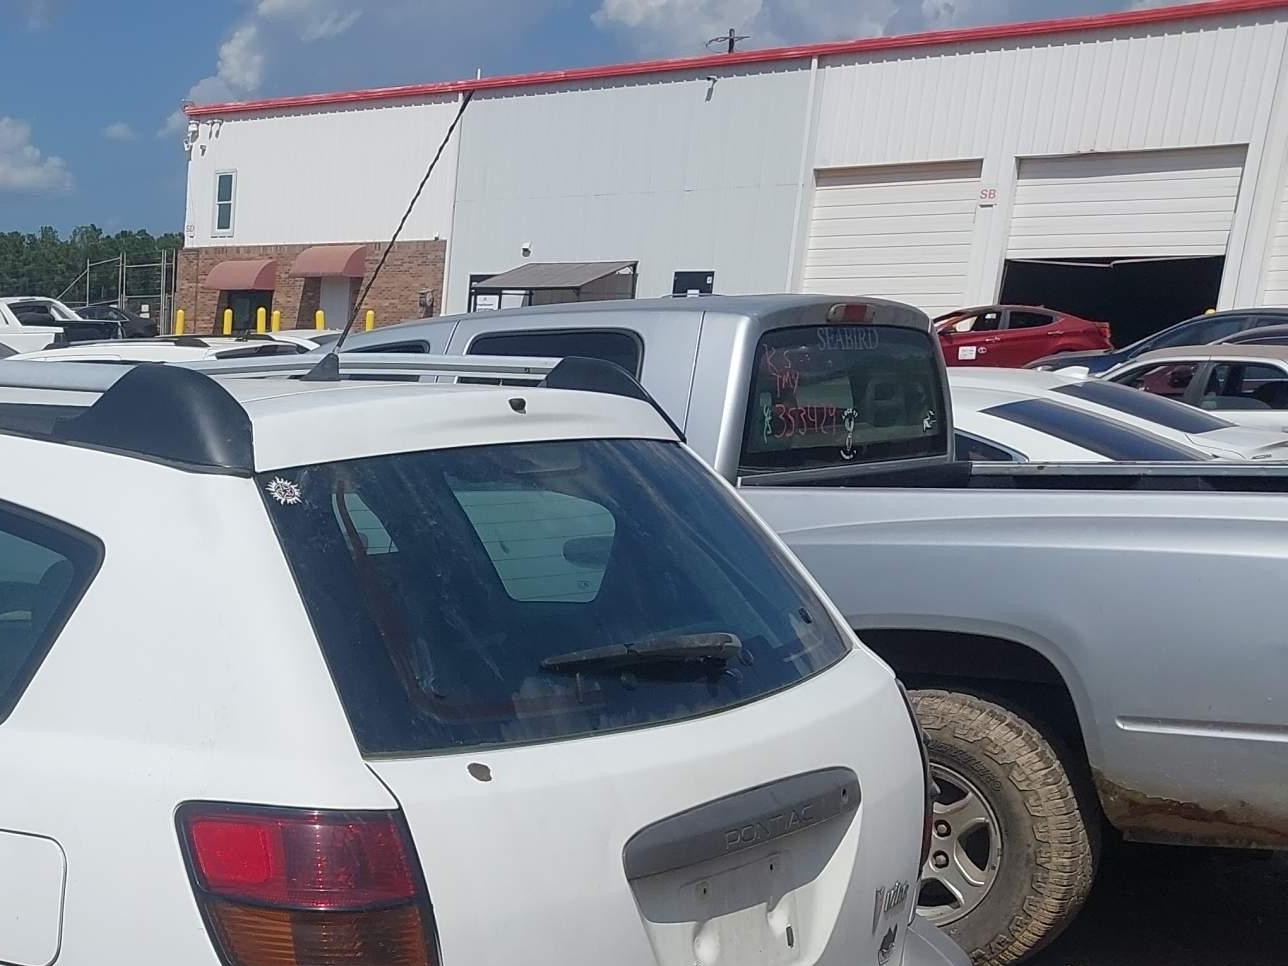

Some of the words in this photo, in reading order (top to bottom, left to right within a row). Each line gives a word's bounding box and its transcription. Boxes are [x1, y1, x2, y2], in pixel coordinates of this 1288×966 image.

[979, 188, 997, 199] SB
[816, 327, 880, 351] SEABIRD
[724, 804, 816, 850] PONTIAC
